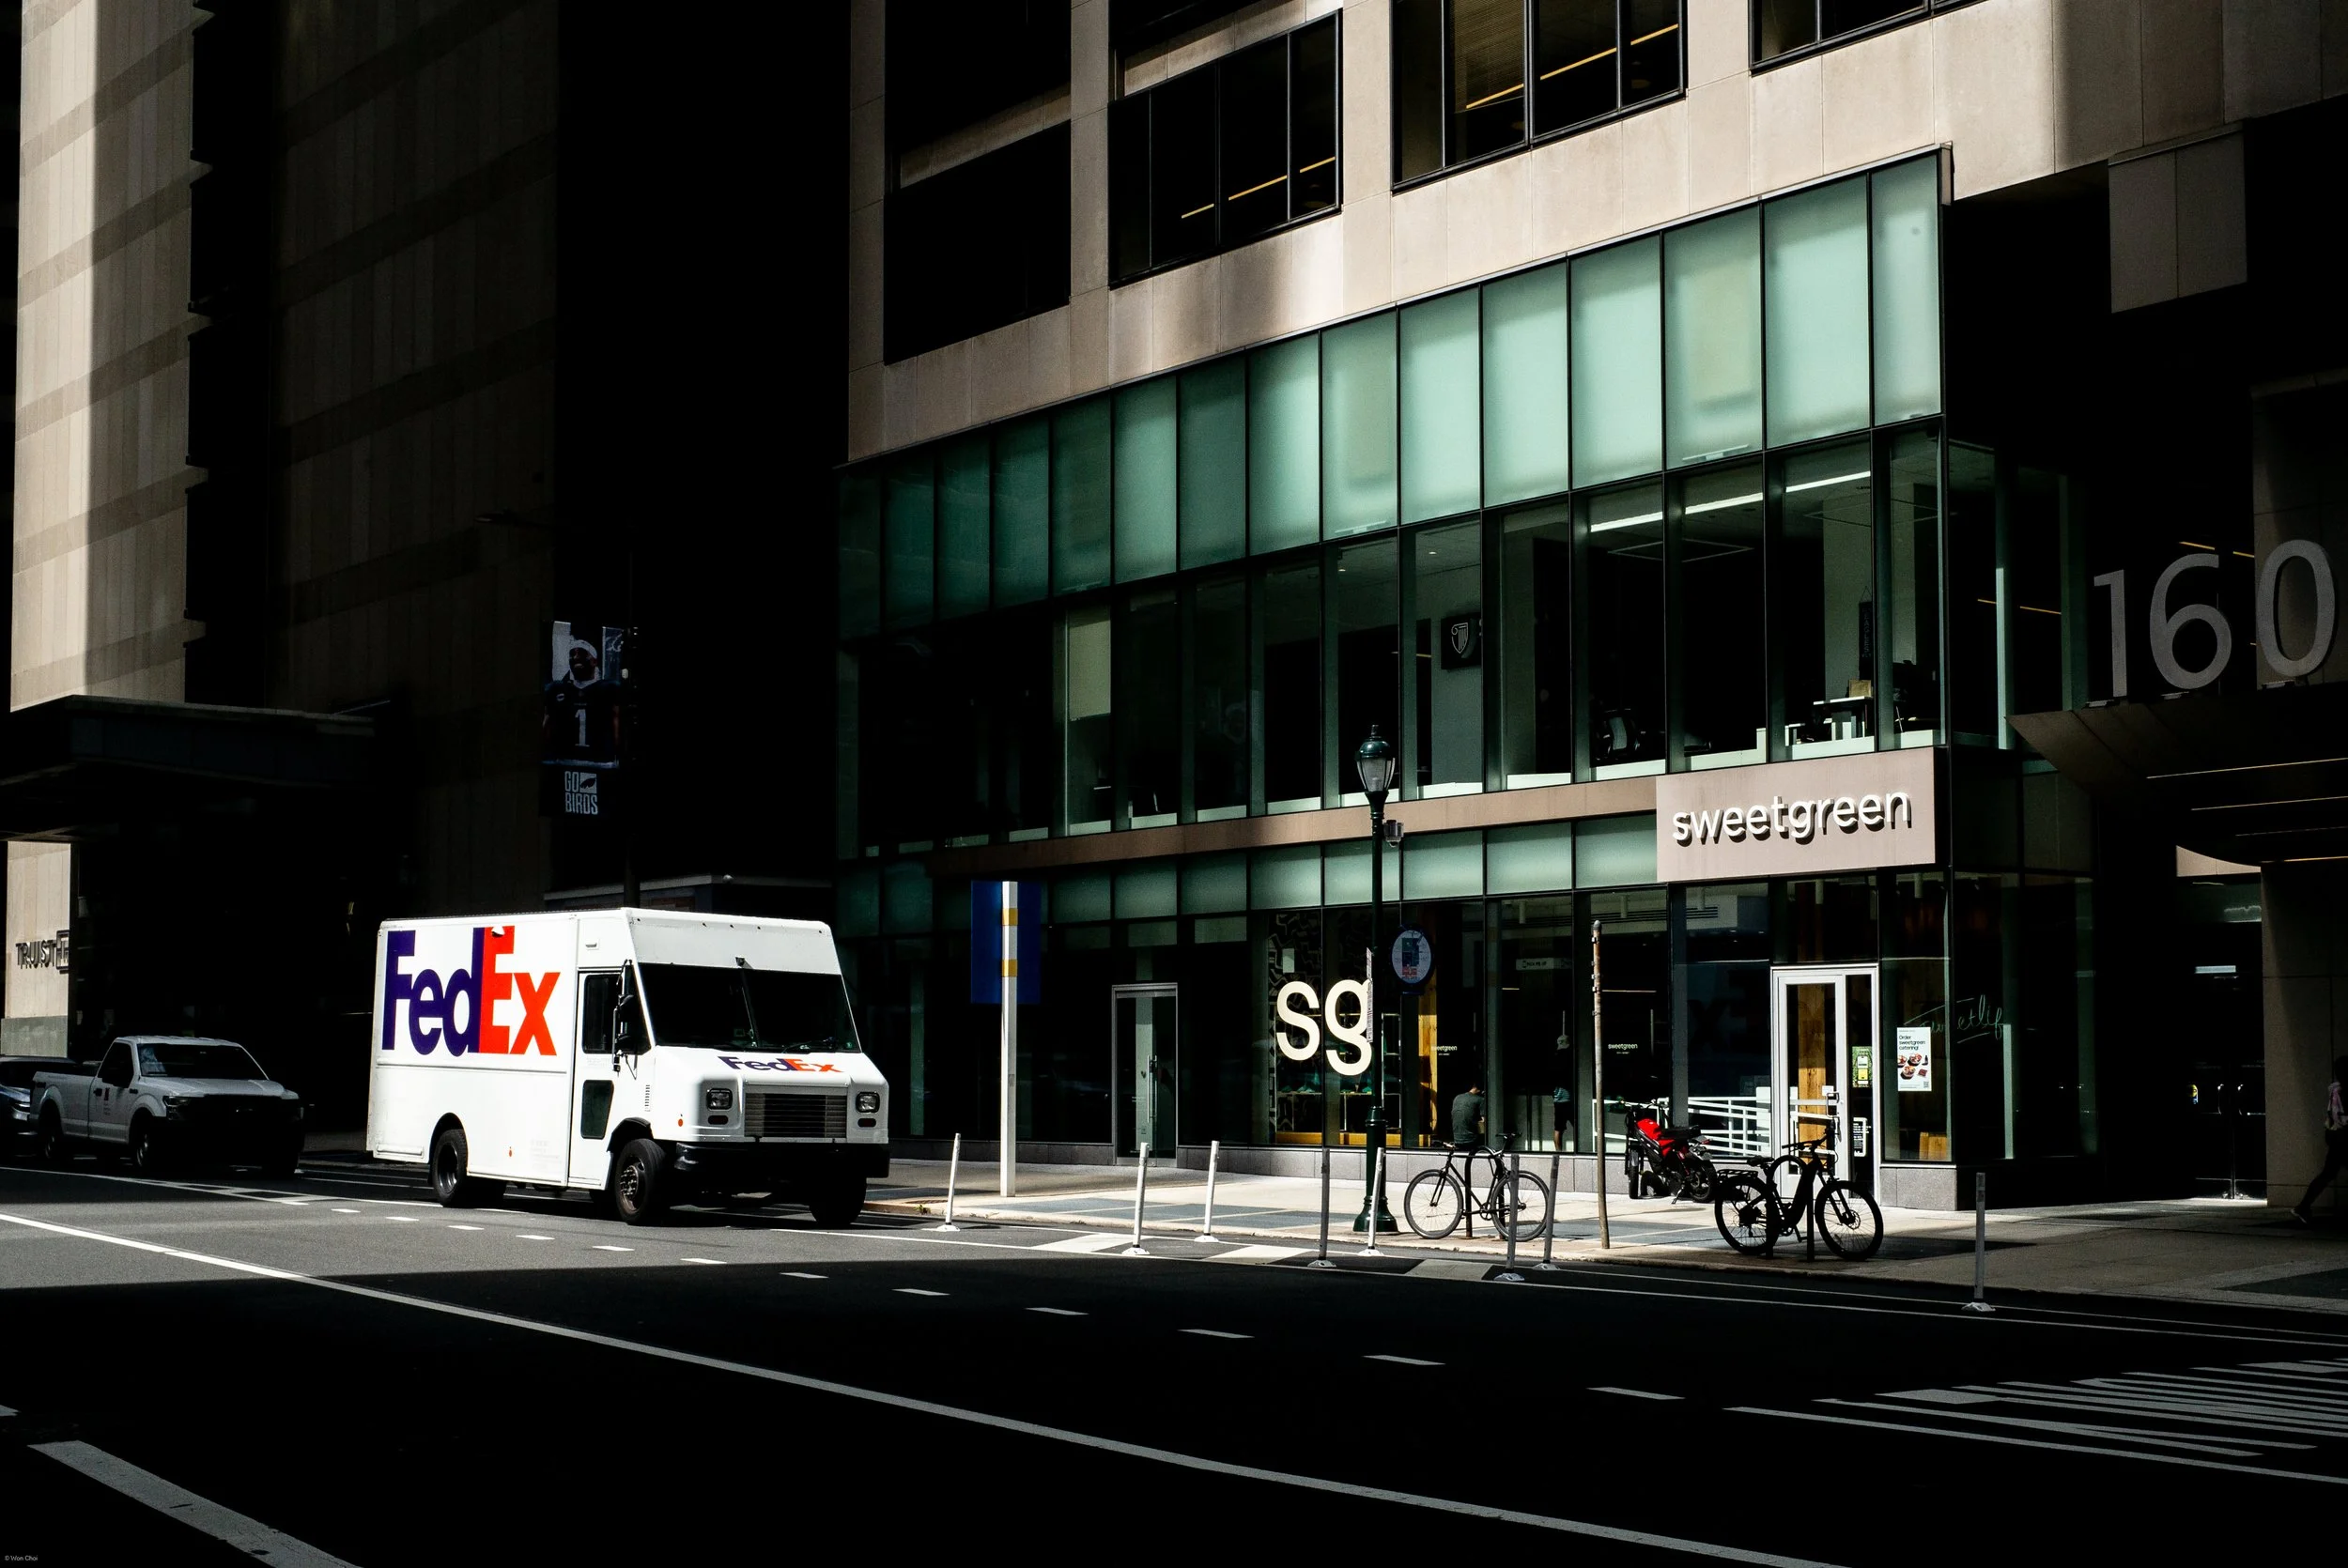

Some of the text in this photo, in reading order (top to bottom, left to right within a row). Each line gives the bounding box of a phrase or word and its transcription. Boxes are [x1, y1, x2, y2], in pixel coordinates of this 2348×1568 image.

[2093, 539, 2336, 698] 160
[575, 709, 590, 747] 1
[564, 771, 579, 792] GO
[564, 792, 598, 815] BIRDS
[1672, 791, 1912, 839] sweetgreen
[15, 940, 57, 968] TRUIST
[382, 925, 561, 1056] FedEx
[1276, 979, 1372, 1076] sg
[718, 1055, 844, 1072] FedEx
